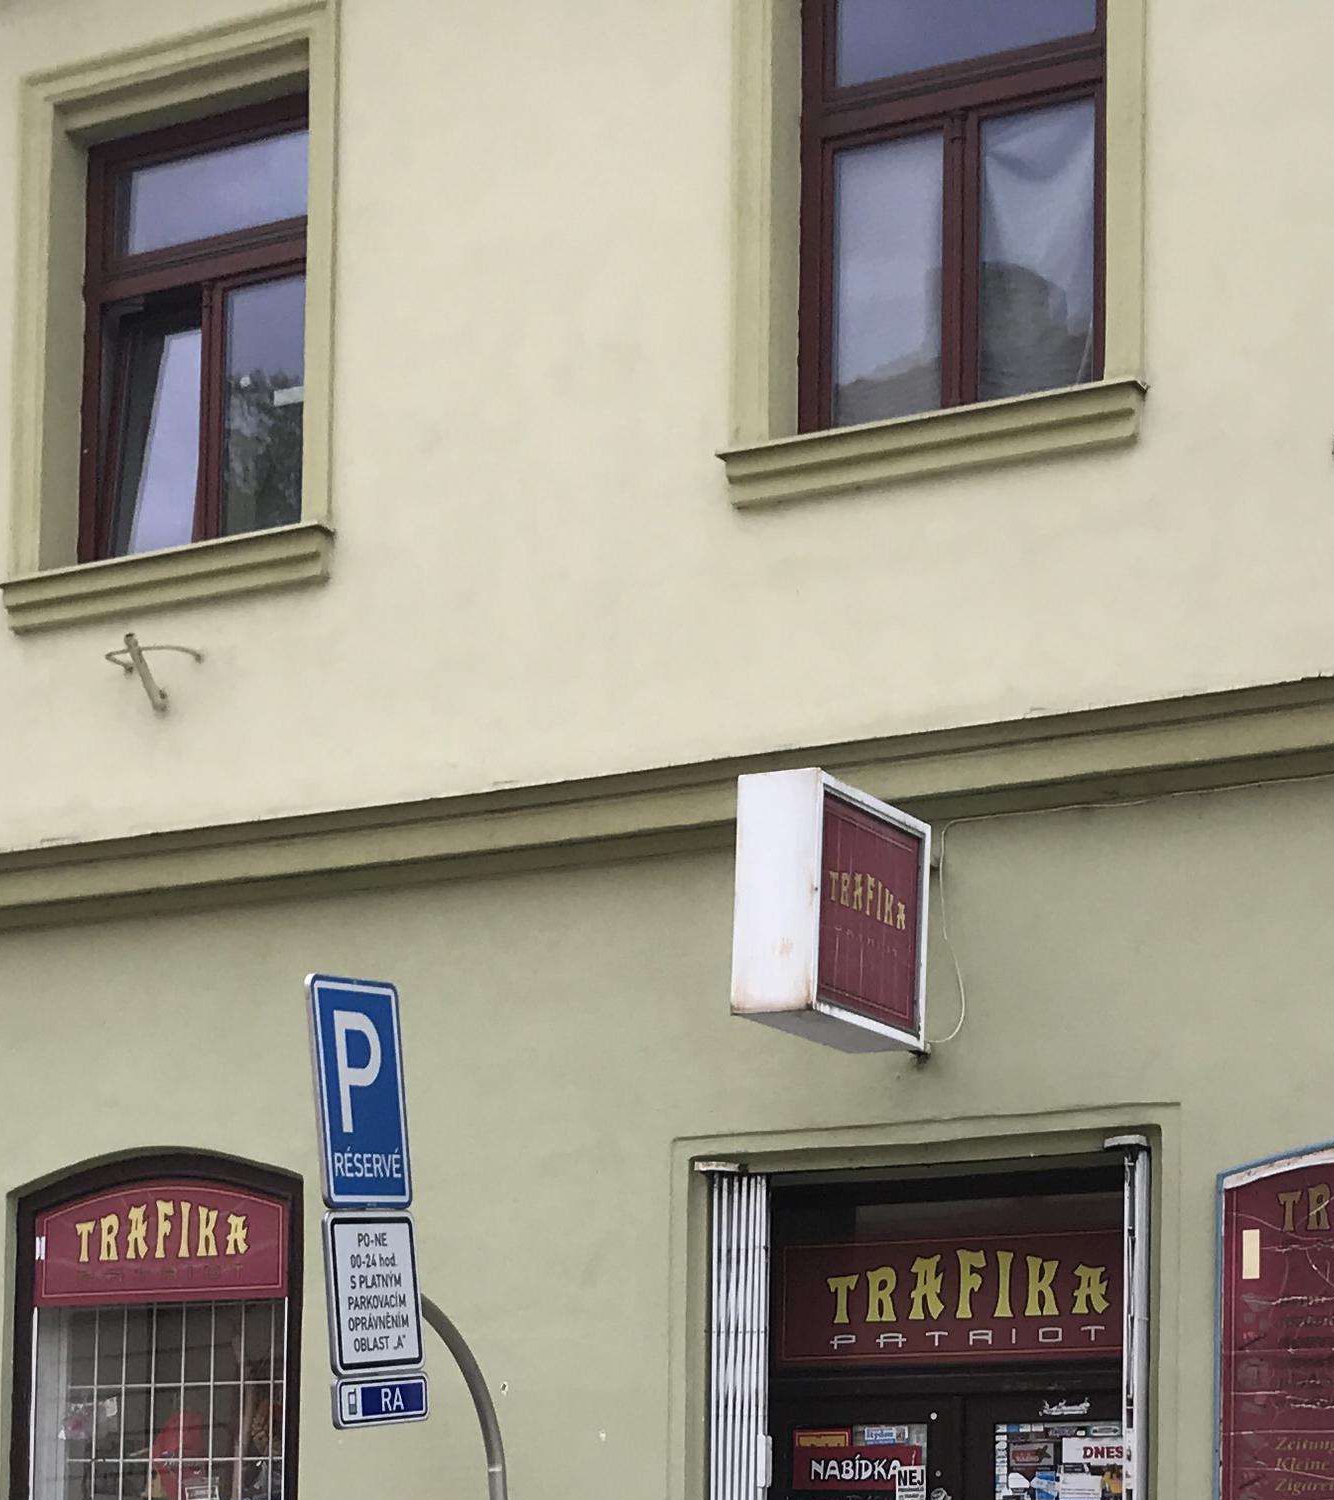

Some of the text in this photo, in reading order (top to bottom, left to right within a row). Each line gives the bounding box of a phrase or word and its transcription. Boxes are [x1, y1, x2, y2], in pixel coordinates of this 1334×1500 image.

[829, 870, 906, 931] TRAFIKA
[333, 1009, 381, 1133] P
[334, 1147, 402, 1179] RÉSERVÉ
[75, 1200, 250, 1263] TRAFIKA
[357, 1233, 387, 1247] PO-NE
[350, 1252, 398, 1268] 00-24 hod.
[350, 1271, 402, 1289] S PLATNÝM
[826, 1249, 1110, 1324] TRAFIKA
[348, 1291, 407, 1311] PARKOVACÍM
[348, 1312, 409, 1332] OPRÁVNĚNÍM
[353, 1335, 390, 1352] OBLAST
[829, 1325, 1106, 1350] PATRIOT
[380, 1387, 405, 1412] RA
[1082, 1446, 1124, 1460] DNES
[810, 1453, 902, 1481] NABÍDKA
[898, 1469, 924, 1486] NEJ
